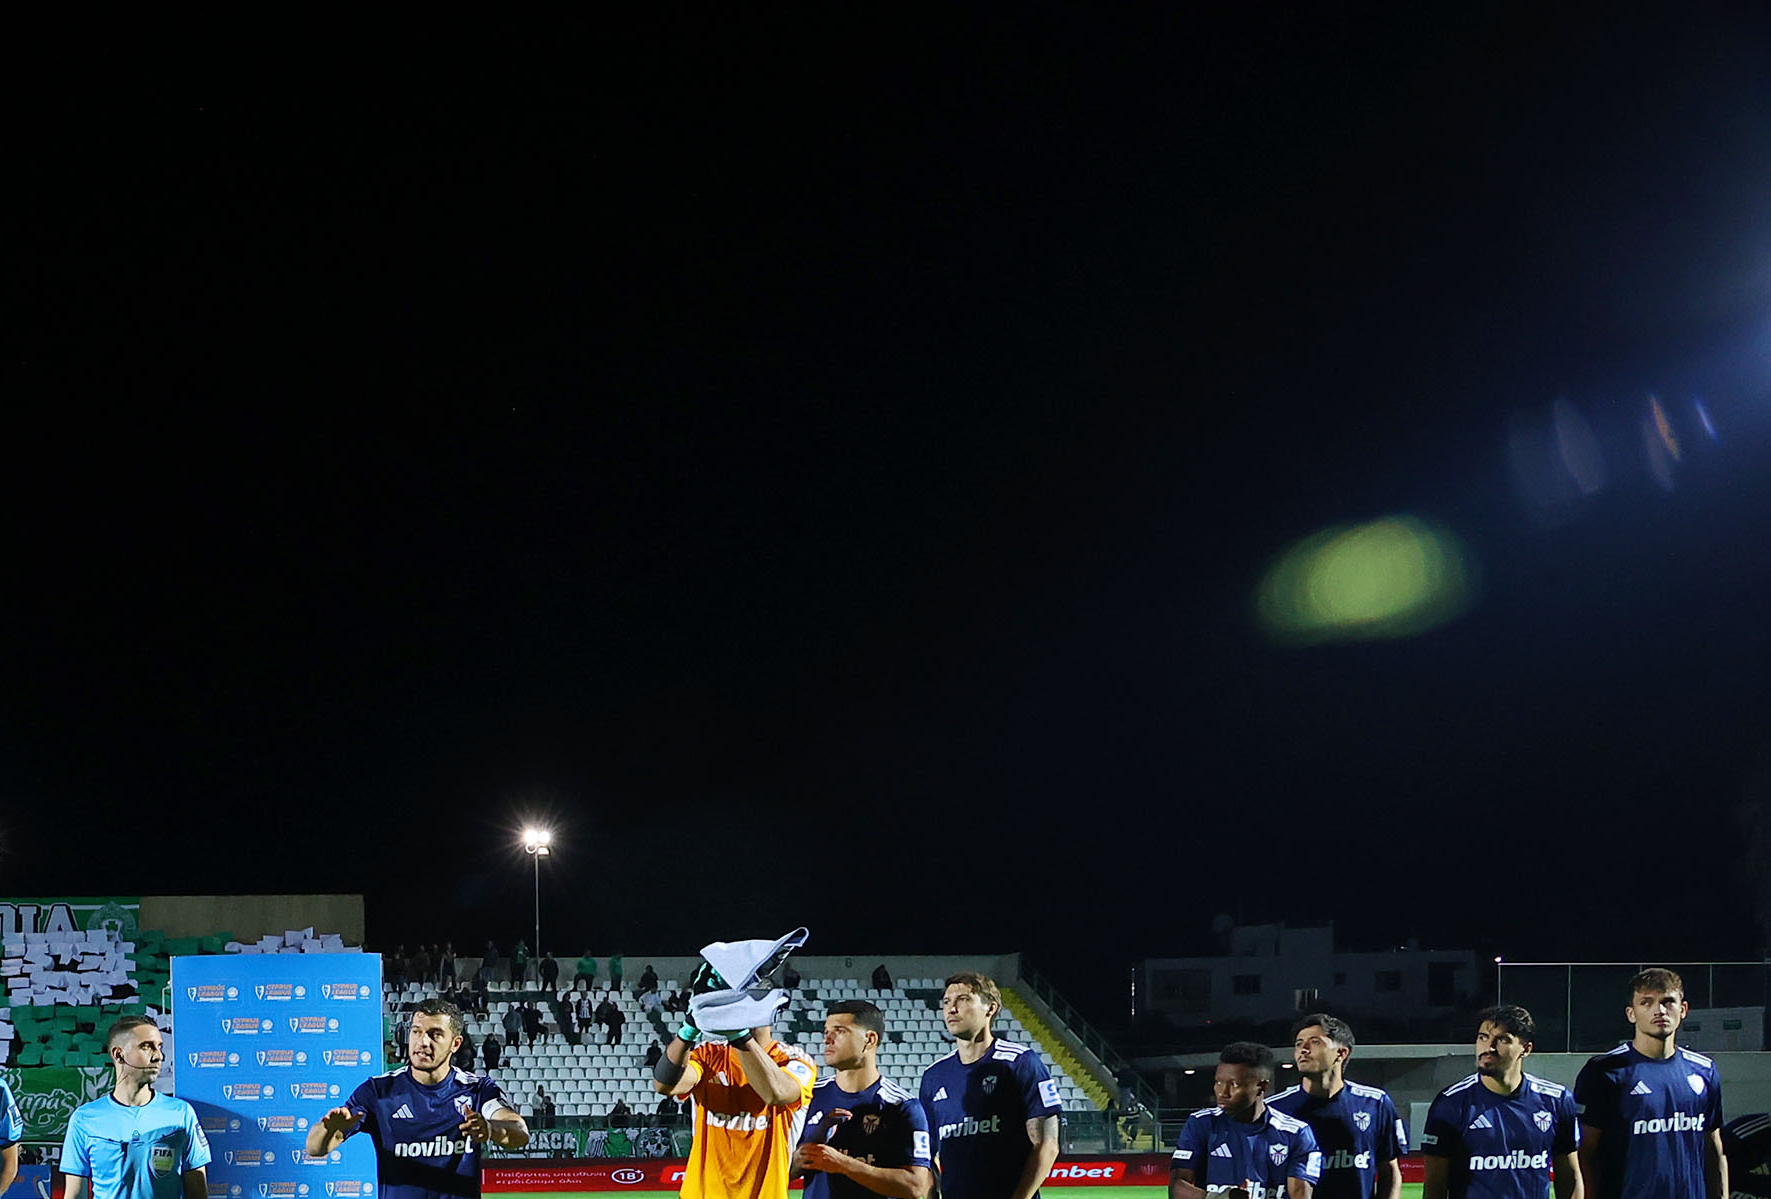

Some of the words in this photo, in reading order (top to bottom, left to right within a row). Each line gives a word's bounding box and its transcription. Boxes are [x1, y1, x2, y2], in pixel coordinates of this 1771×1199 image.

[1633, 1112, 1706, 1135] novibet
[154, 1148, 173, 1158] FIFA
[395, 1135, 473, 1158] novibet
[1469, 1150, 1548, 1170] novibet
